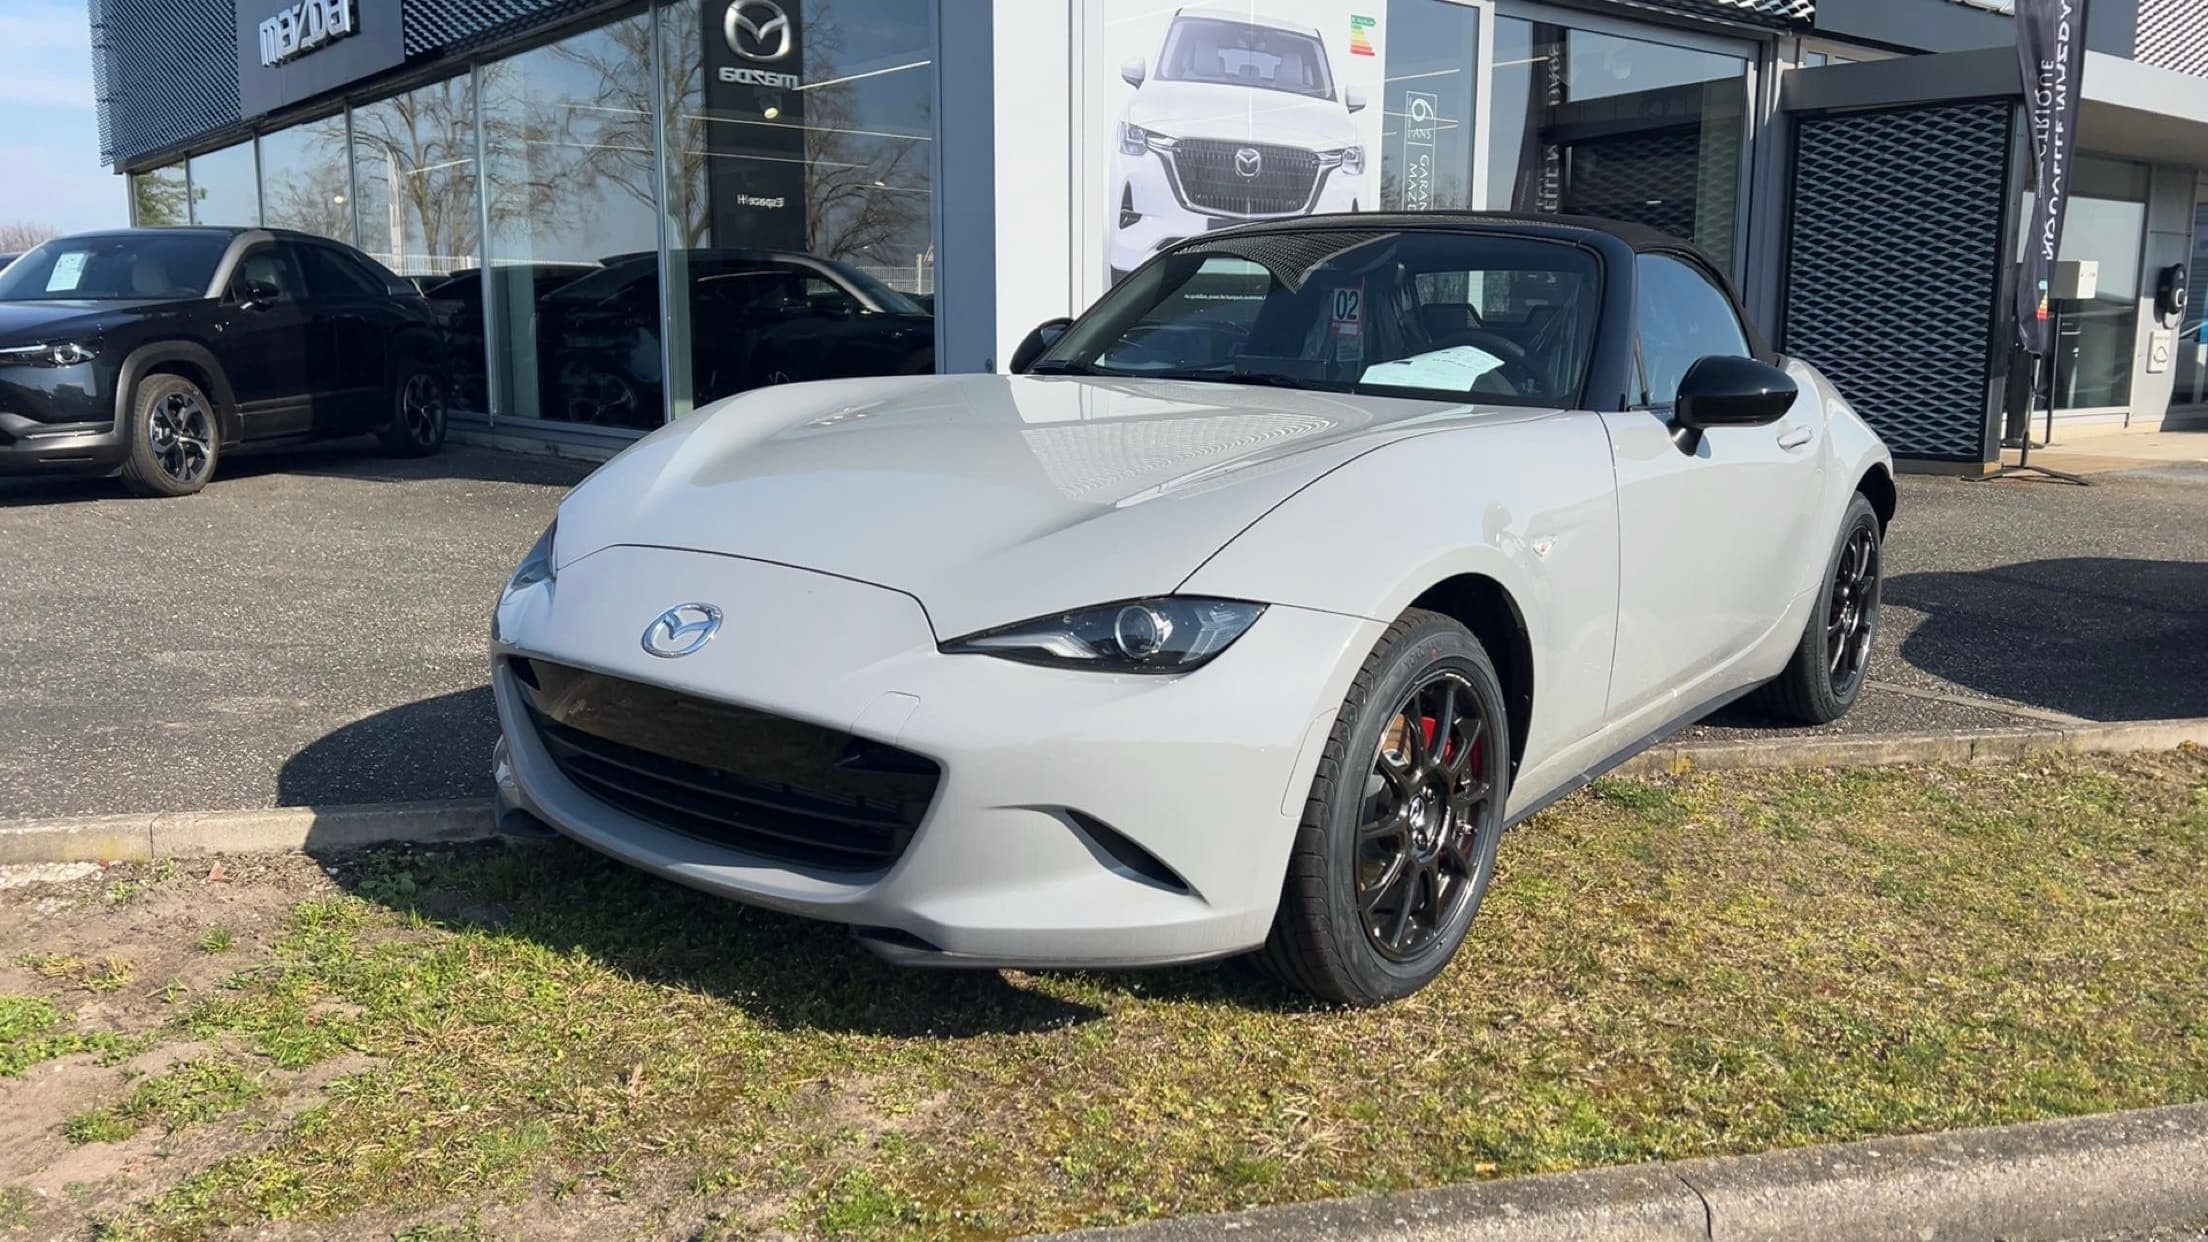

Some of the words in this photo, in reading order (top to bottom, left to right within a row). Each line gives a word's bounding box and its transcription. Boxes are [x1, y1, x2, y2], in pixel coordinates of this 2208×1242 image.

[1411, 98, 1434, 122] 6
[1419, 154, 1430, 212] GARAN
[1336, 290, 1359, 321] 02
